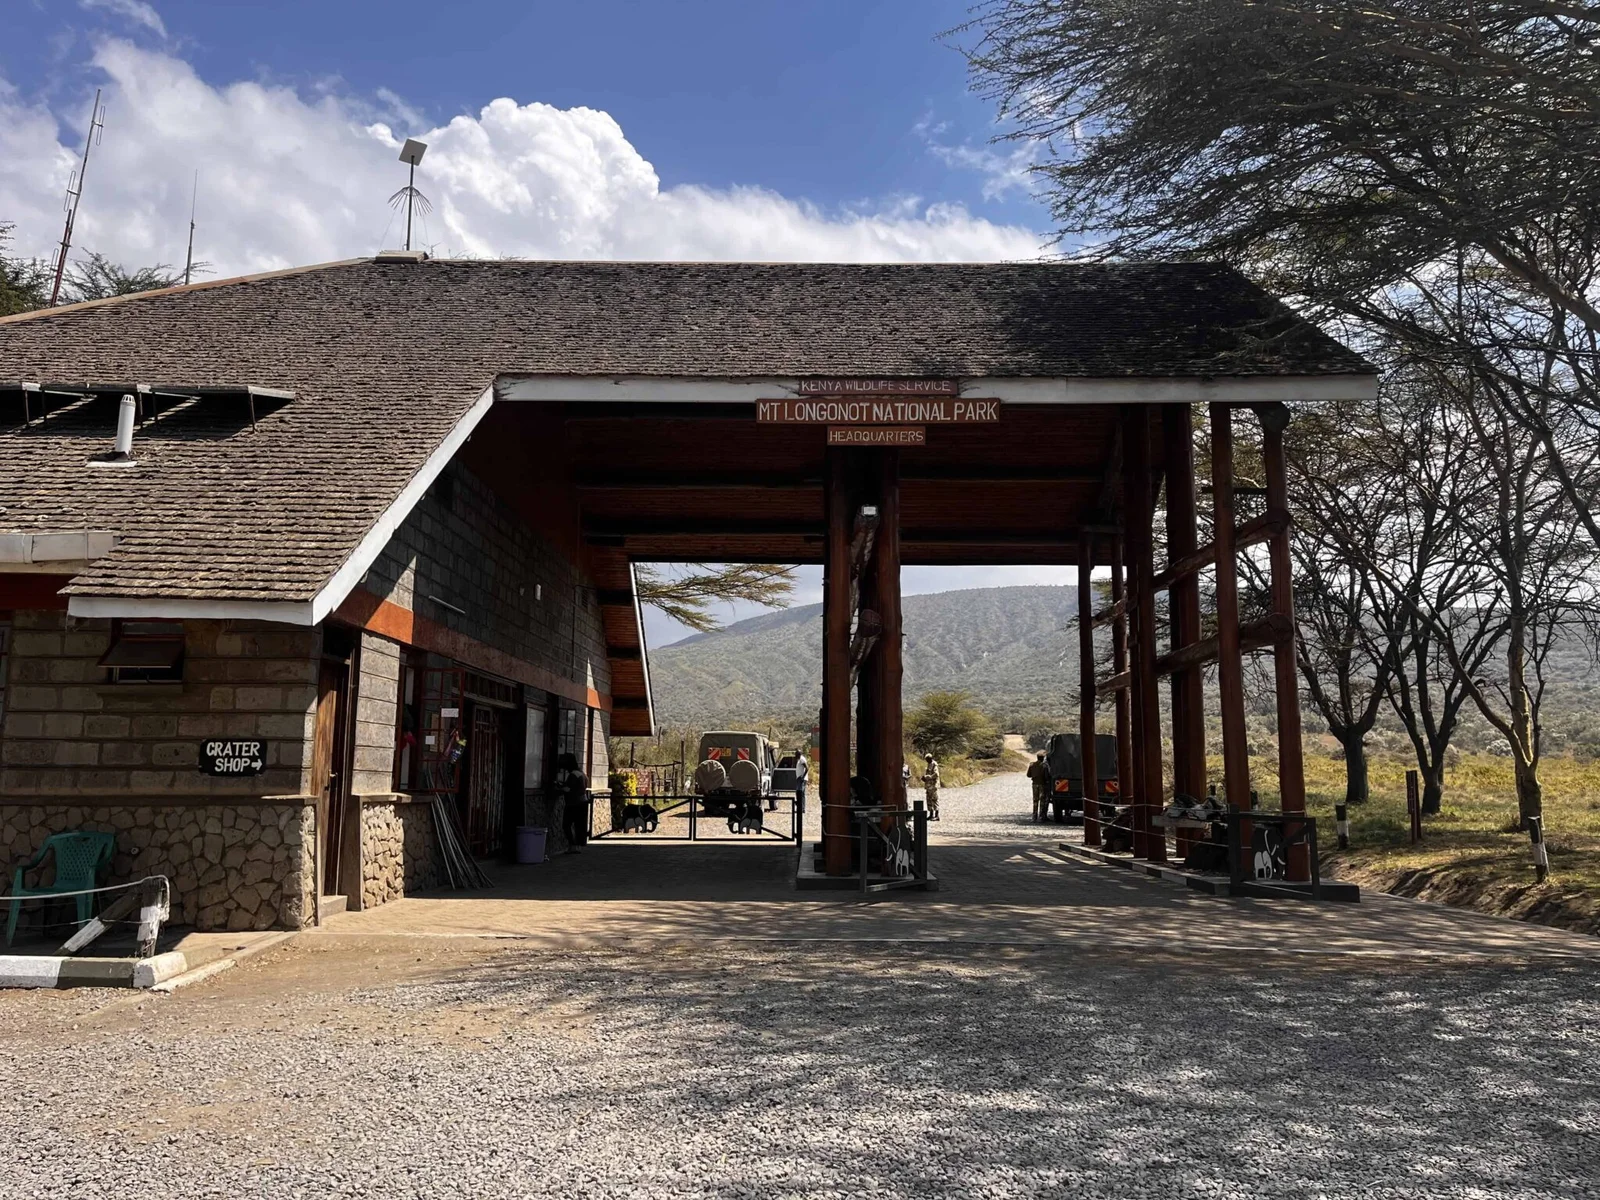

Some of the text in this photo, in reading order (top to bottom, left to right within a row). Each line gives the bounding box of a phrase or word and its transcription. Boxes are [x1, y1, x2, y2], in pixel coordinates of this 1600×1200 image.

[801, 380, 951, 392] KENYA WILDLIFE SERVICE
[759, 401, 998, 421] MT LONGONOT NATIONAL PARK
[829, 430, 924, 442] HEADQUARTERS
[206, 741, 261, 757] CRATER
[214, 757, 251, 772] SHOP
